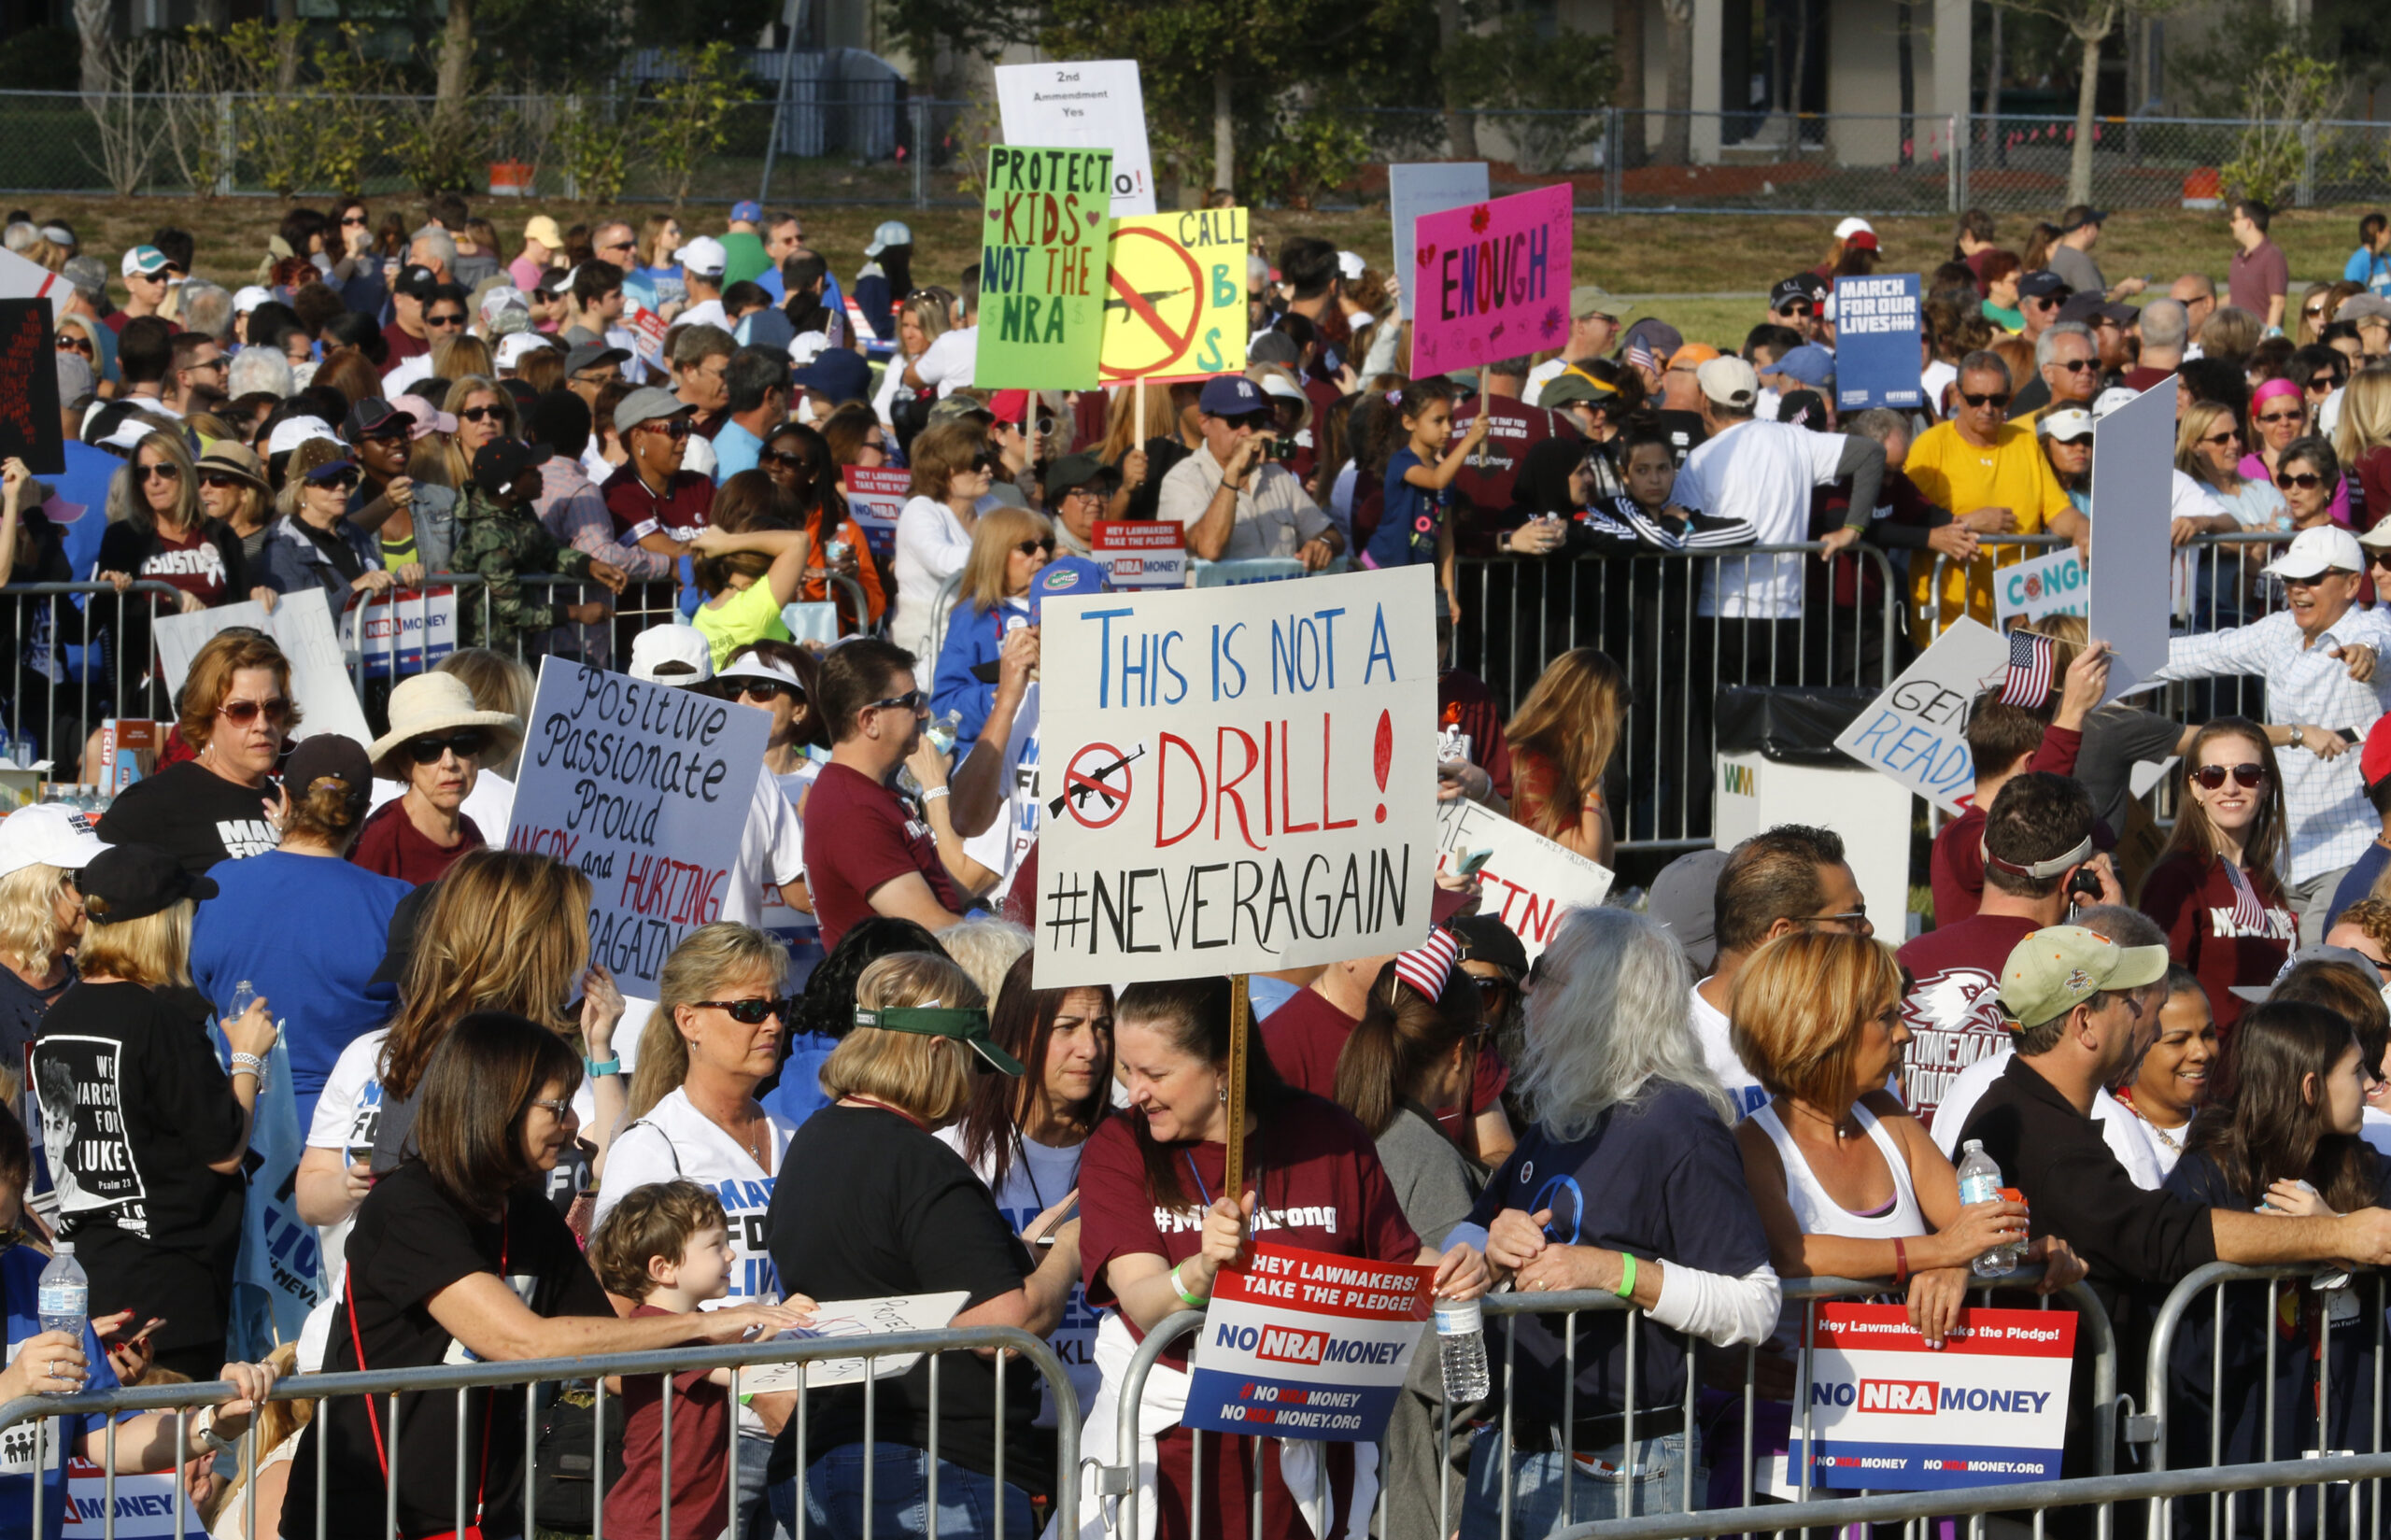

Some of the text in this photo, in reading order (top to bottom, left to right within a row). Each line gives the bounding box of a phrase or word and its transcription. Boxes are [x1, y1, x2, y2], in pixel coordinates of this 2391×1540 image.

[1056, 71, 1081, 82] 2nd
[1033, 90, 1109, 102] Ammendment
[1062, 107, 1084, 118] Yes
[989, 148, 1113, 193] PROTECT
[1002, 191, 1081, 247] KIDS
[1178, 209, 1245, 248] CALL
[982, 246, 1092, 296] NOT THE
[1441, 223, 1549, 321] ENOUGH
[1839, 278, 1905, 299] MARCH
[999, 295, 1065, 344] NRA
[1839, 295, 1917, 317] FOR OUR
[1840, 315, 1890, 334] LIVES
[854, 480, 875, 490] TAKE
[875, 482, 892, 491] THE
[854, 503, 898, 518] NO NRA
[1103, 536, 1177, 546] TAKE THE PLEDGE!
[1105, 525, 1176, 536] HEY LAWMAKERS!
[1115, 560, 1141, 573] NRA
[1142, 560, 1181, 572] MONEY
[366, 618, 403, 637] NRA
[402, 614, 447, 632] MONEY
[1081, 601, 1396, 709] THIS IS NOT A
[571, 665, 728, 747] Positive
[537, 712, 727, 803] Passionate
[1154, 708, 1394, 851] DRILL!
[1723, 762, 1755, 798] WM
[566, 778, 663, 847] Proud
[581, 850, 615, 880] and
[619, 852, 728, 926] HURTING
[1045, 843, 1409, 954] #NEVERAGAIN
[1904, 1029, 2014, 1067] TONEMAN
[96, 1055, 115, 1079] WE
[94, 1110, 120, 1134] FOR
[98, 1178, 132, 1191] Psalm 23
[545, 1161, 589, 1201] FO
[1252, 1253, 1420, 1293] HEY LAWMAKERS!
[1243, 1275, 1415, 1312] TAKE THE PLEDGE!
[1215, 1322, 1406, 1365] NO NRA MONEY
[1818, 1319, 2059, 1342] Hey Lawmake ake the Pledge!
[1812, 1381, 2051, 1414] NO NRA MONEY
[1220, 1404, 1362, 1430] NONRAMONEY.ORG
[1923, 1459, 2044, 1475] NONRAMONEY.ORG
[75, 1493, 175, 1519] MONEY
